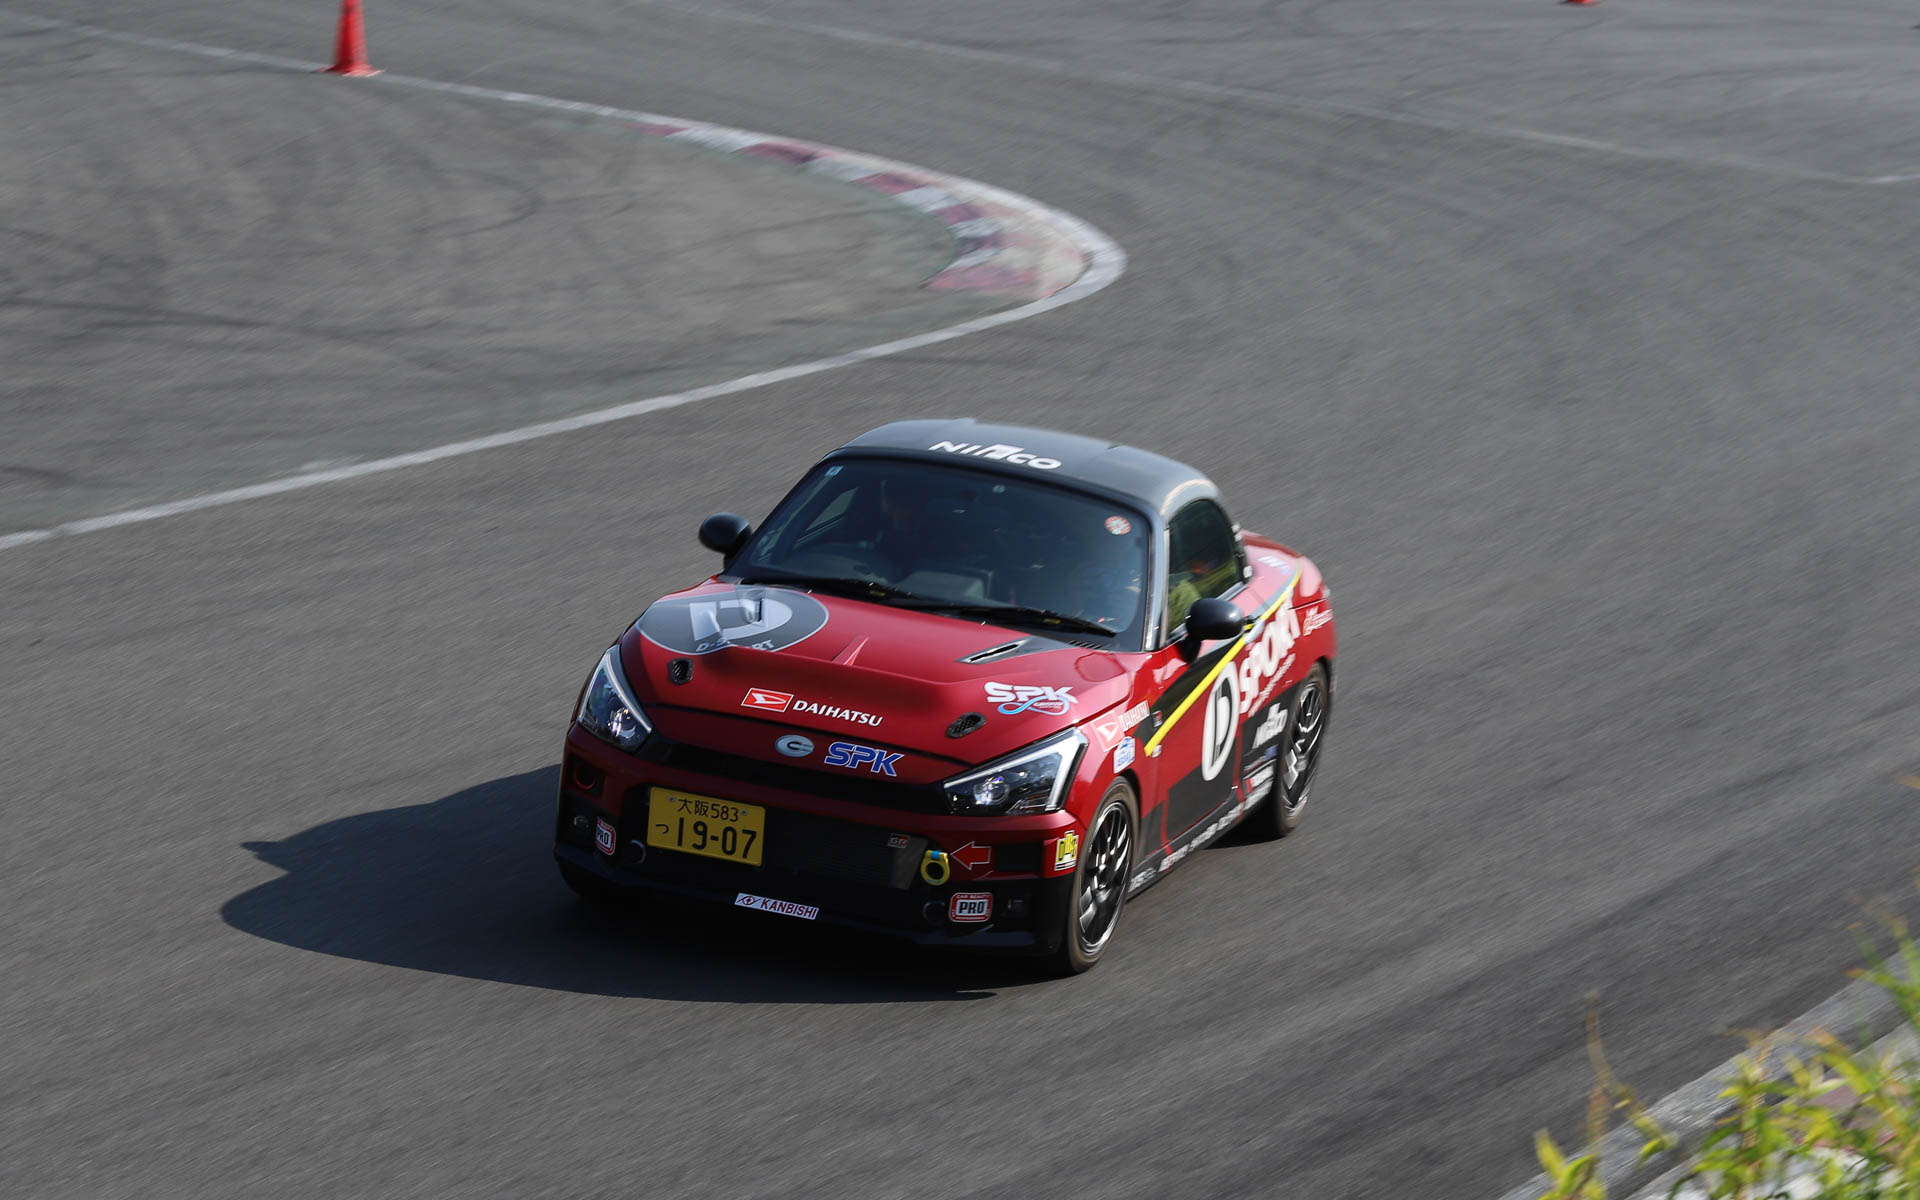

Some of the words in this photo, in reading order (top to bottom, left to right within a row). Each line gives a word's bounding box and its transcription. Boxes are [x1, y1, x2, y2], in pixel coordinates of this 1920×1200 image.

[984, 681, 1078, 704] SPK
[792, 700, 884, 727] DAIHATSU
[824, 741, 904, 777] SPK
[655, 823, 669, 835] つ
[677, 817, 757, 859] 19-07
[760, 898, 817, 918] KANBISHI
[958, 901, 985, 914] PRO
